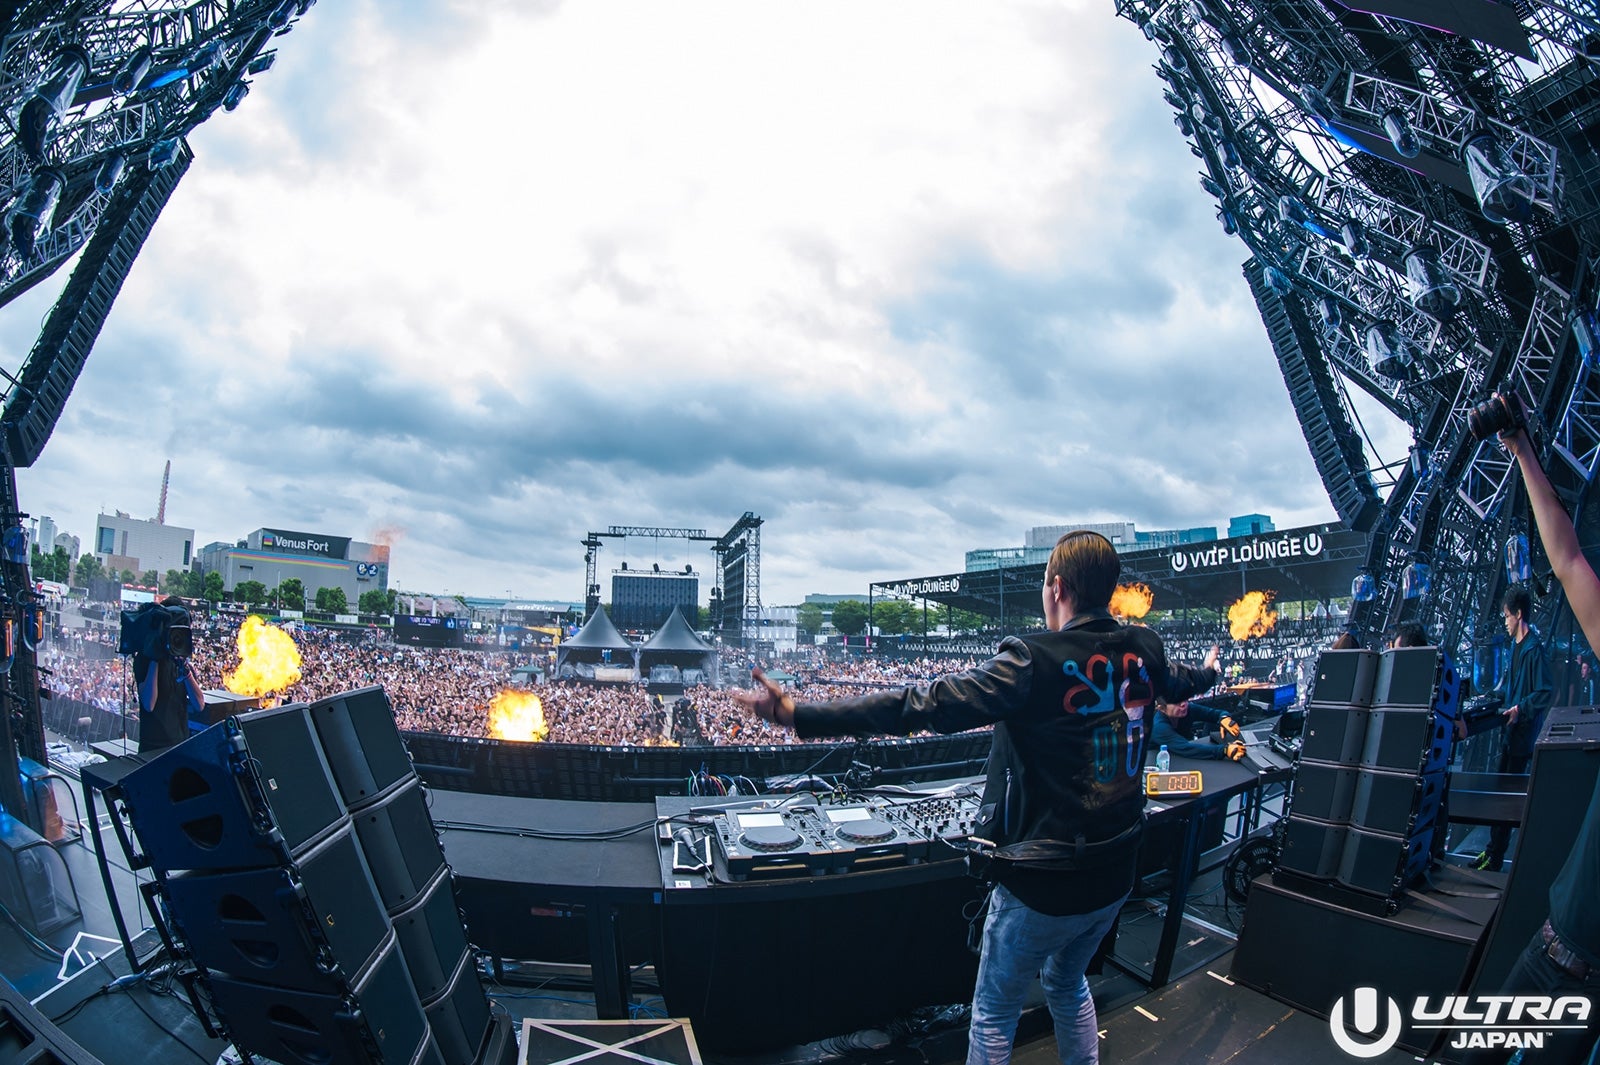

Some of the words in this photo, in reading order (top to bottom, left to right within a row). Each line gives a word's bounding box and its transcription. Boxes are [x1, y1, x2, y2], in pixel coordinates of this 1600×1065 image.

[1190, 547, 1229, 568] VVIP
[1232, 538, 1301, 563] LOUNGE
[919, 580, 950, 593] LOUNGE
[1168, 775, 1198, 790] 0:00
